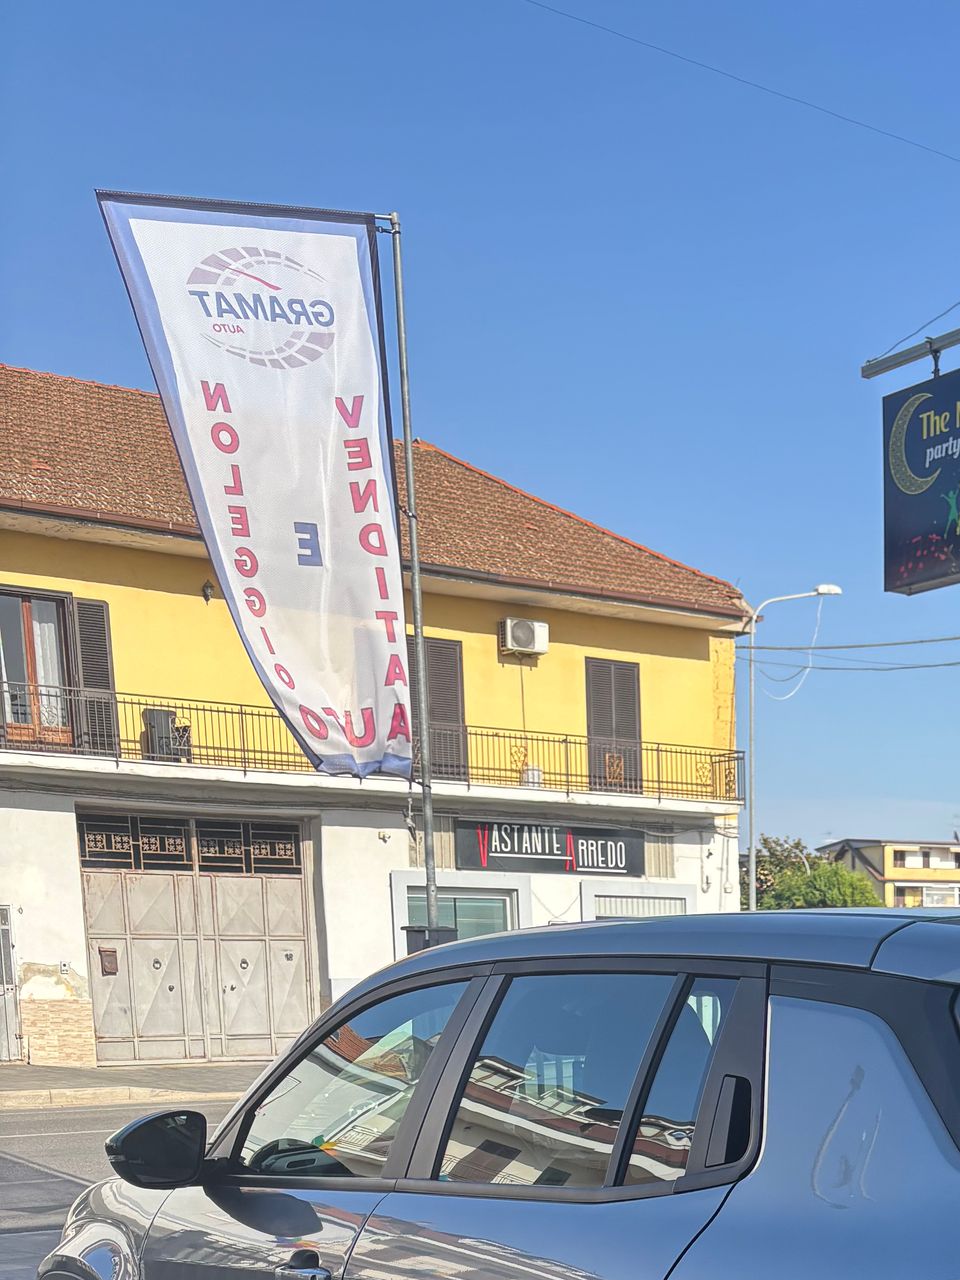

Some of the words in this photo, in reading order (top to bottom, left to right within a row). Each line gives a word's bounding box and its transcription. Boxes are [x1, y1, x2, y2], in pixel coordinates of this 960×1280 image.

[919, 410, 950, 440] The
[925, 436, 960, 468] party
[476, 823, 562, 868] VASTANTE
[565, 828, 627, 872] ARREDO
